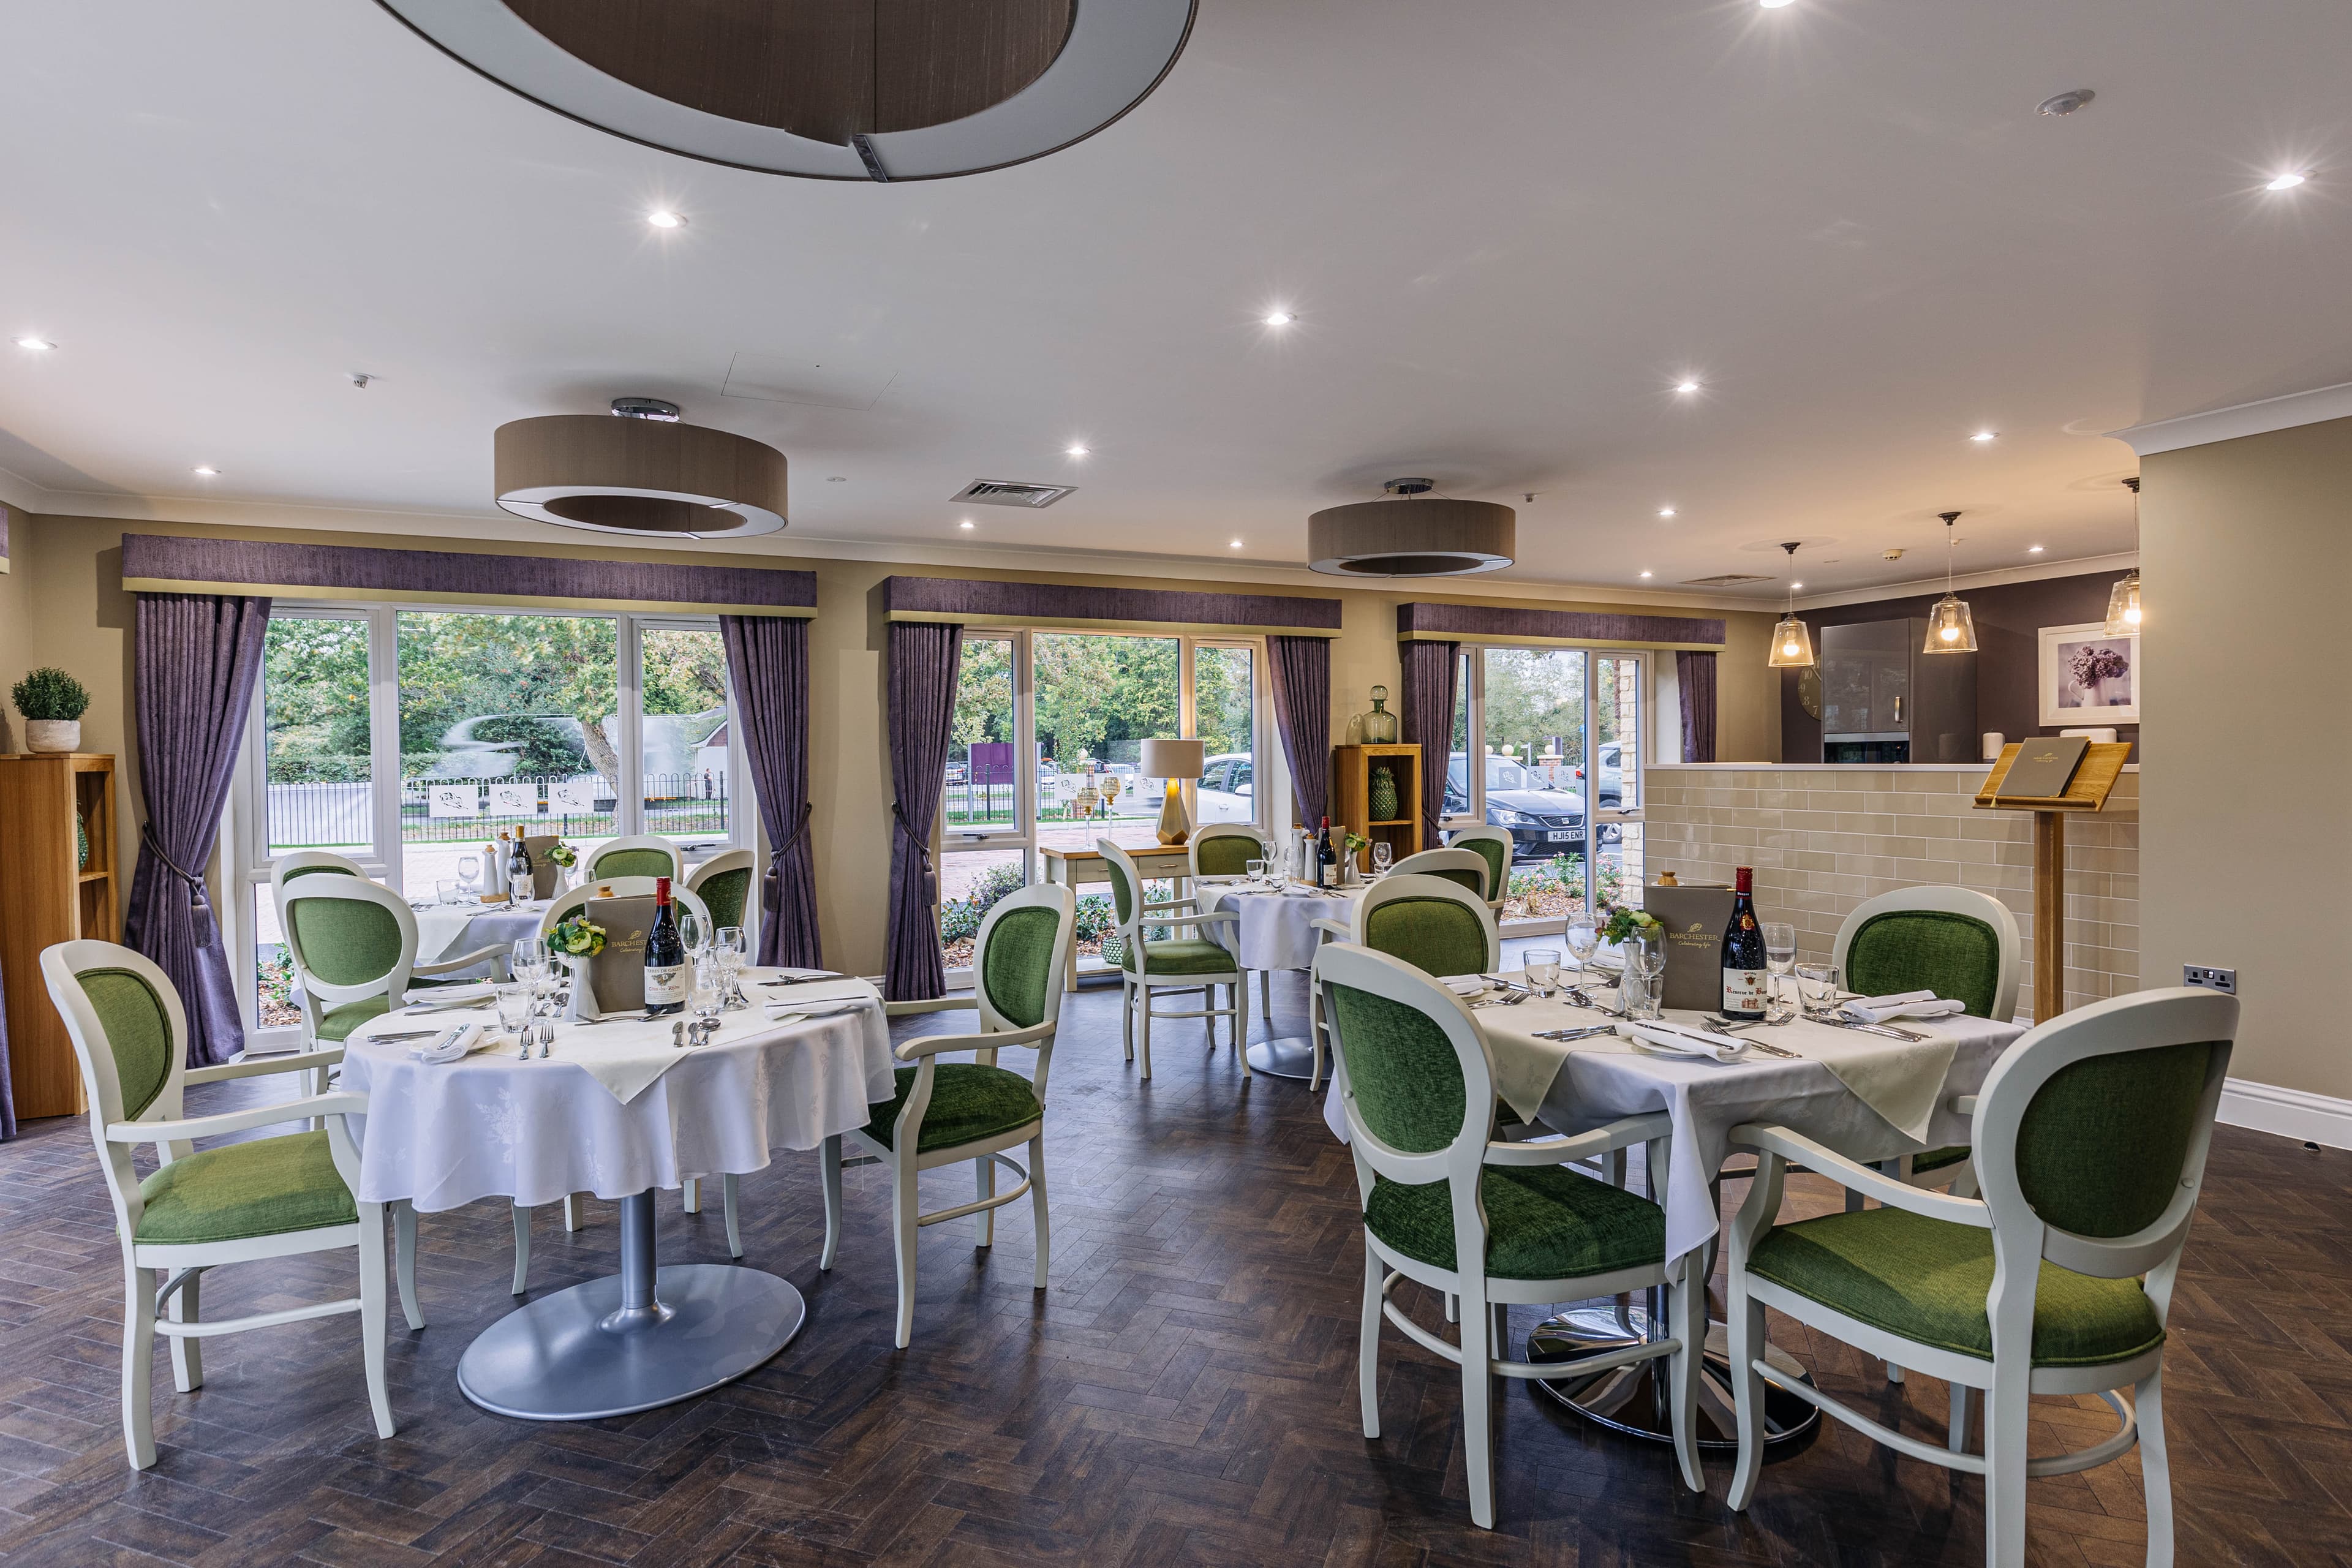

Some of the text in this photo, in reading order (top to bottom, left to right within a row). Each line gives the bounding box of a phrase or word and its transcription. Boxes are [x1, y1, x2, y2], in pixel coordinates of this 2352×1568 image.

[1804, 671, 1812, 680] 10
[1800, 684, 1806, 693] 9
[1804, 696, 1809, 706] 8
[1813, 706, 1819, 715] 7
[1670, 933, 1721, 941] BARCHESTER
